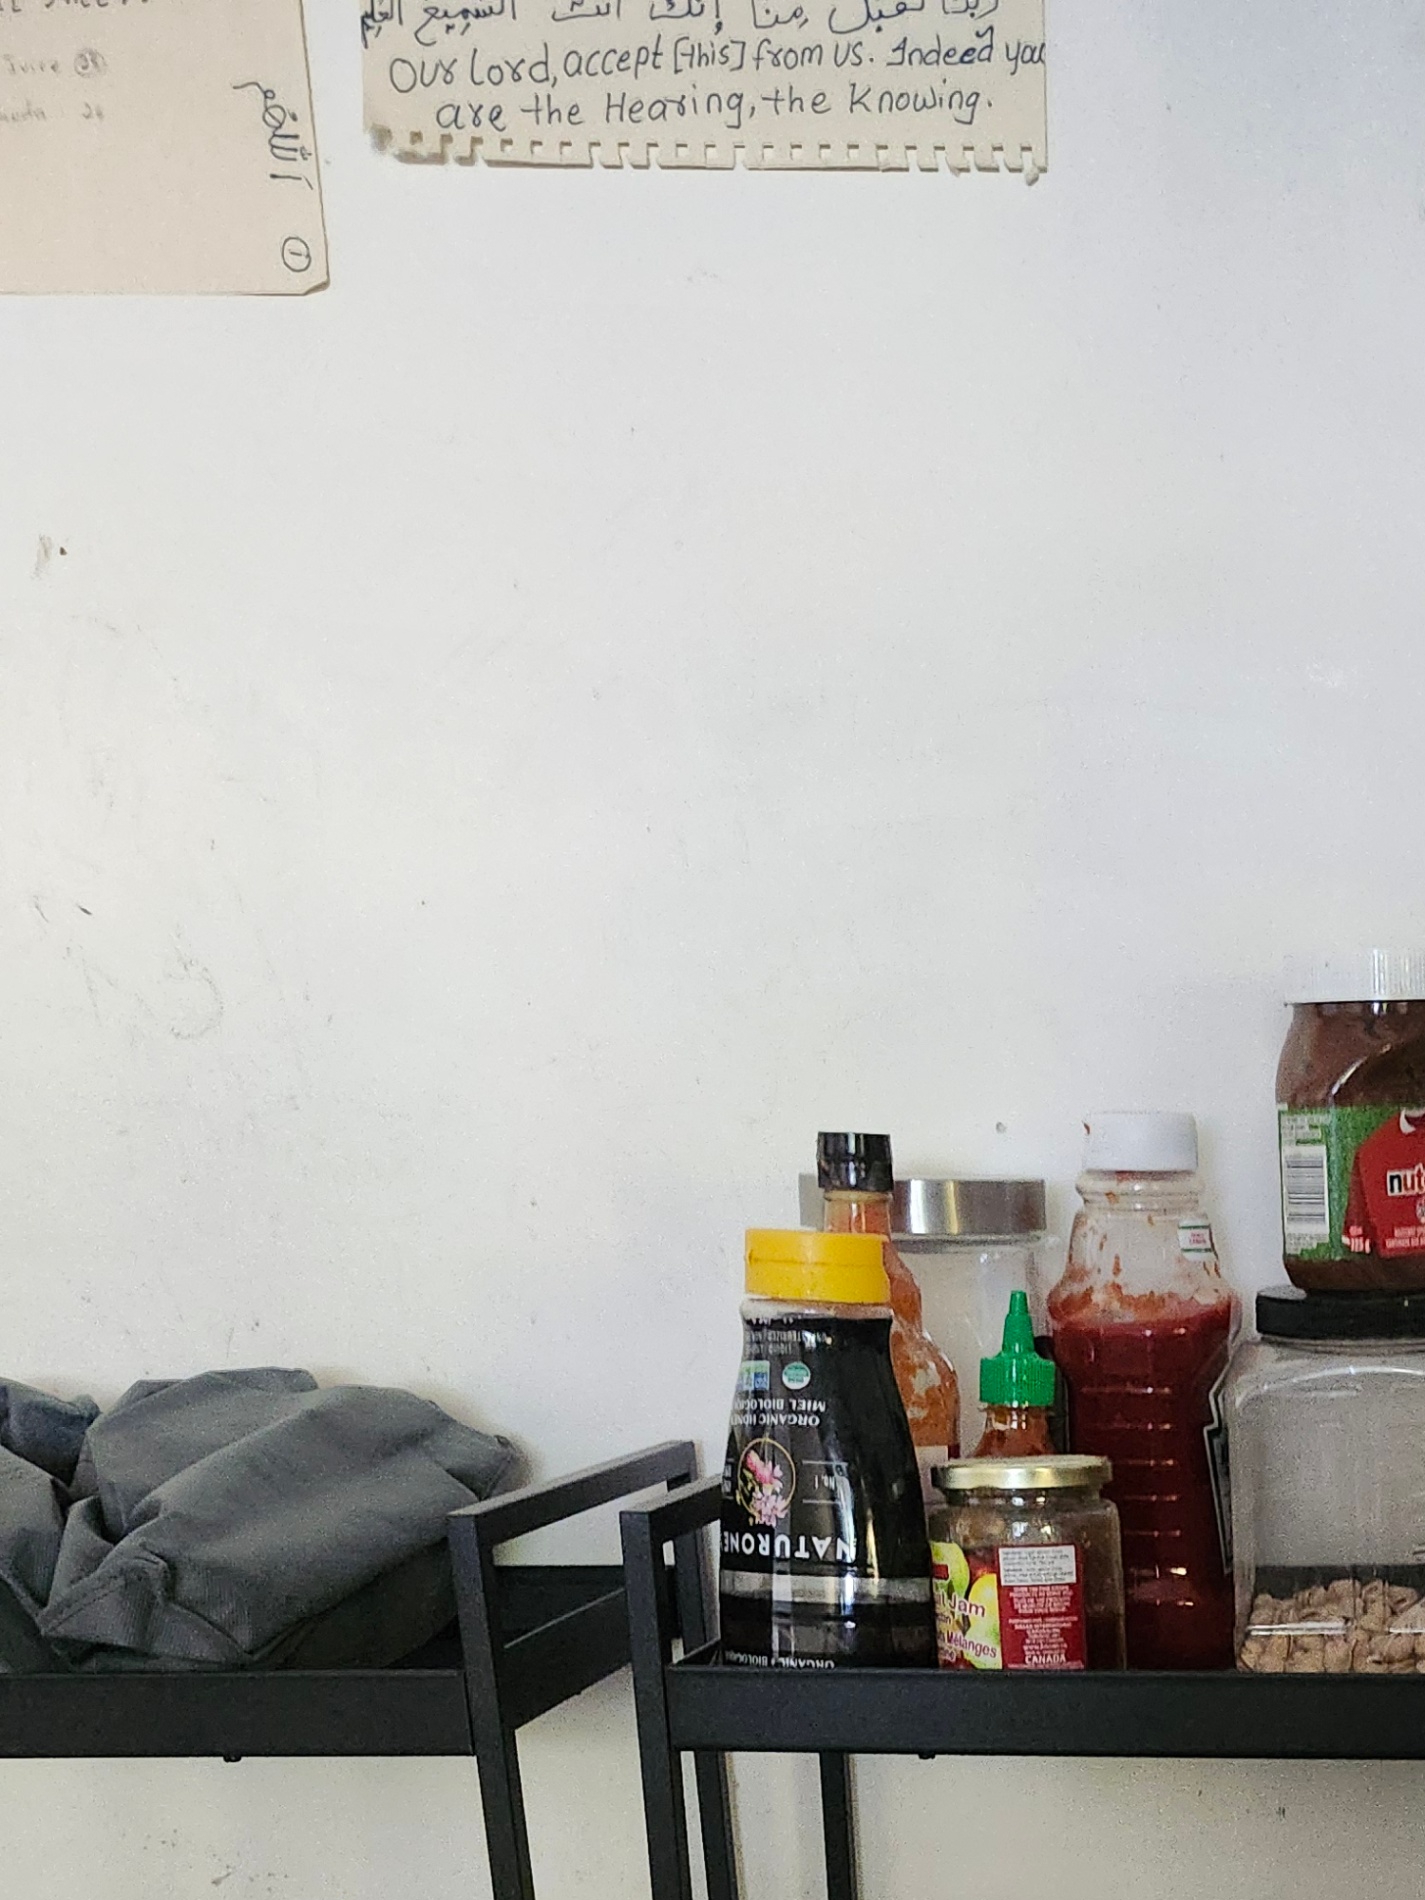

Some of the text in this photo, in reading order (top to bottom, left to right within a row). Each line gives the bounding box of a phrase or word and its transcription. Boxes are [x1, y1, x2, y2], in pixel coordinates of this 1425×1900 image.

[564, 34, 664, 79] accept
[674, 36, 746, 72] [this]
[753, 39, 822, 71] from
[887, 26, 994, 66] Indeed
[436, 79, 993, 131] are the Hearing, the Knowing.
[789, 1399, 826, 1412] MIEL
[759, 1413, 820, 1426] ORGANIC
[950, 1592, 986, 1618] Jam
[1025, 1654, 1066, 1664] CANADA
